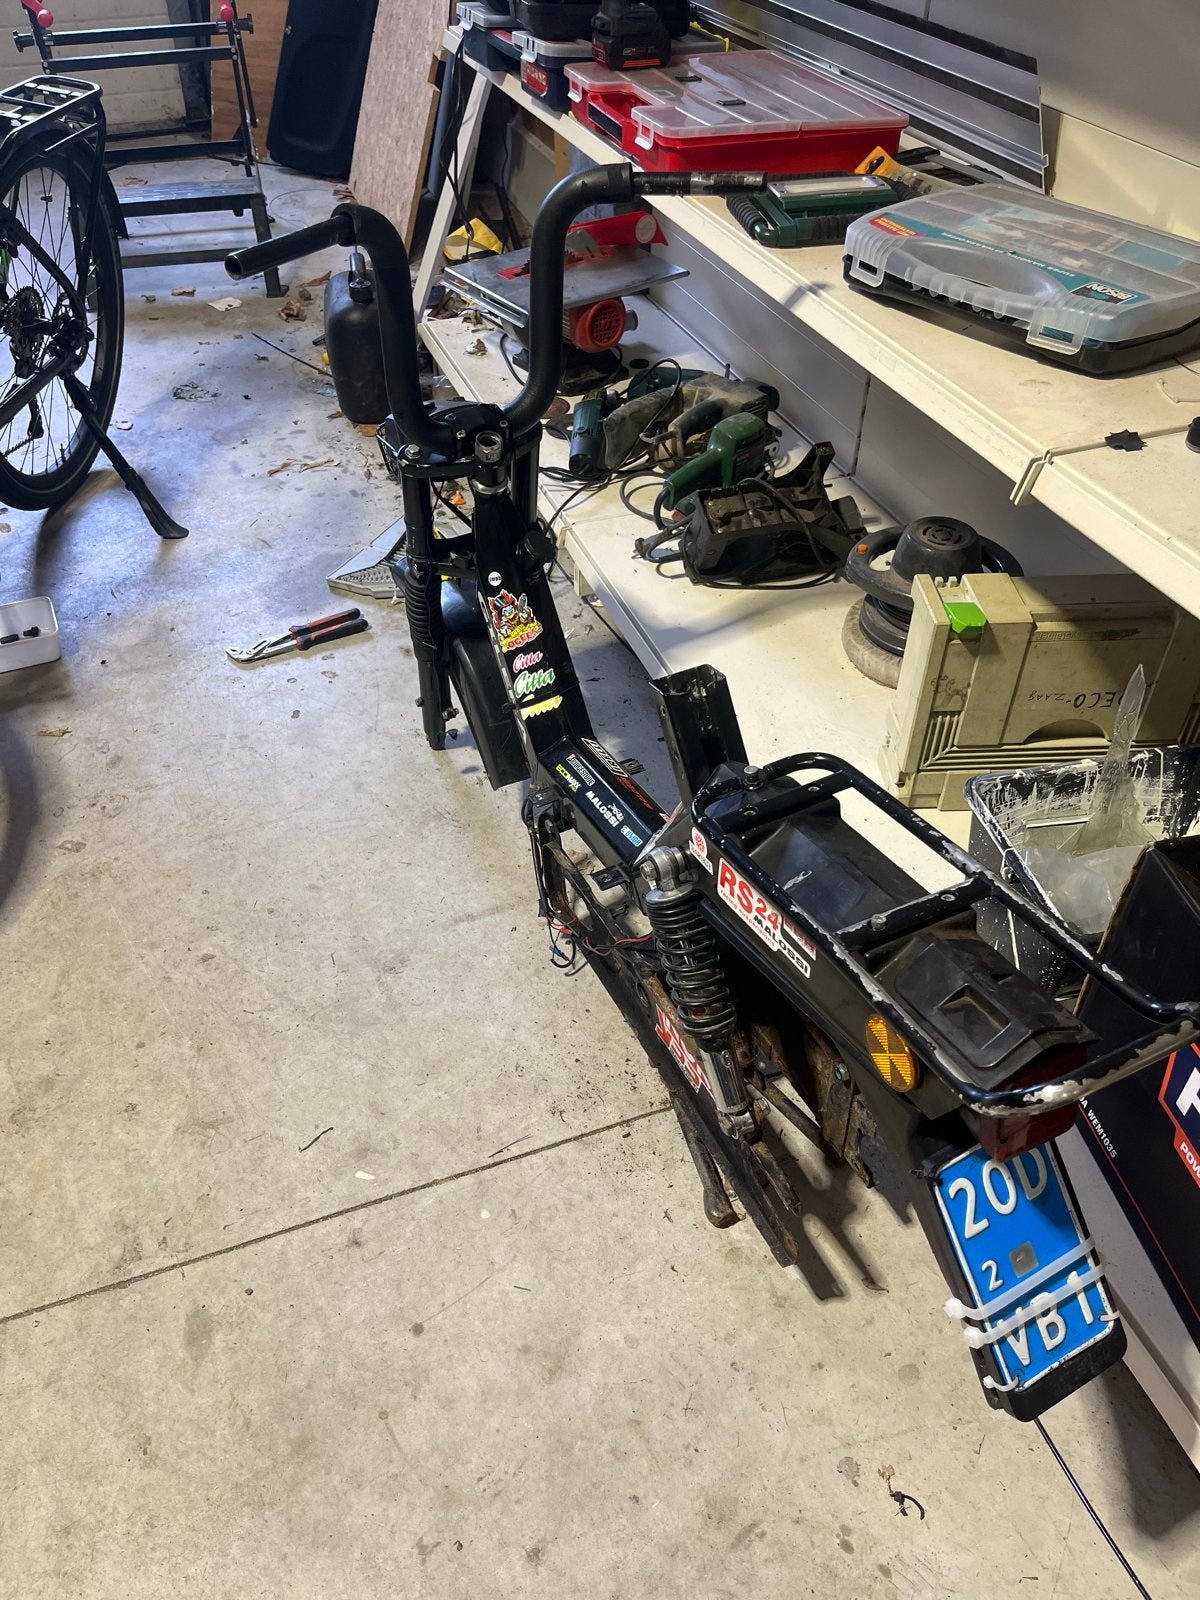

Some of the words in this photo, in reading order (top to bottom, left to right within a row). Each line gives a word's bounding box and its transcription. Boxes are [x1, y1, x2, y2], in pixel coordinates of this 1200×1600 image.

[1088, 283, 1133, 300] BISON
[513, 651, 543, 674] Citta
[514, 668, 555, 698] Citta
[585, 790, 620, 827] MALOSSI
[719, 861, 779, 931] RS24
[720, 889, 739, 911] racing
[753, 914, 809, 975] MALOSSI
[1087, 1109, 1118, 1159] WEM1035
[948, 1148, 1048, 1239] 20D
[981, 1260, 1004, 1292] 2
